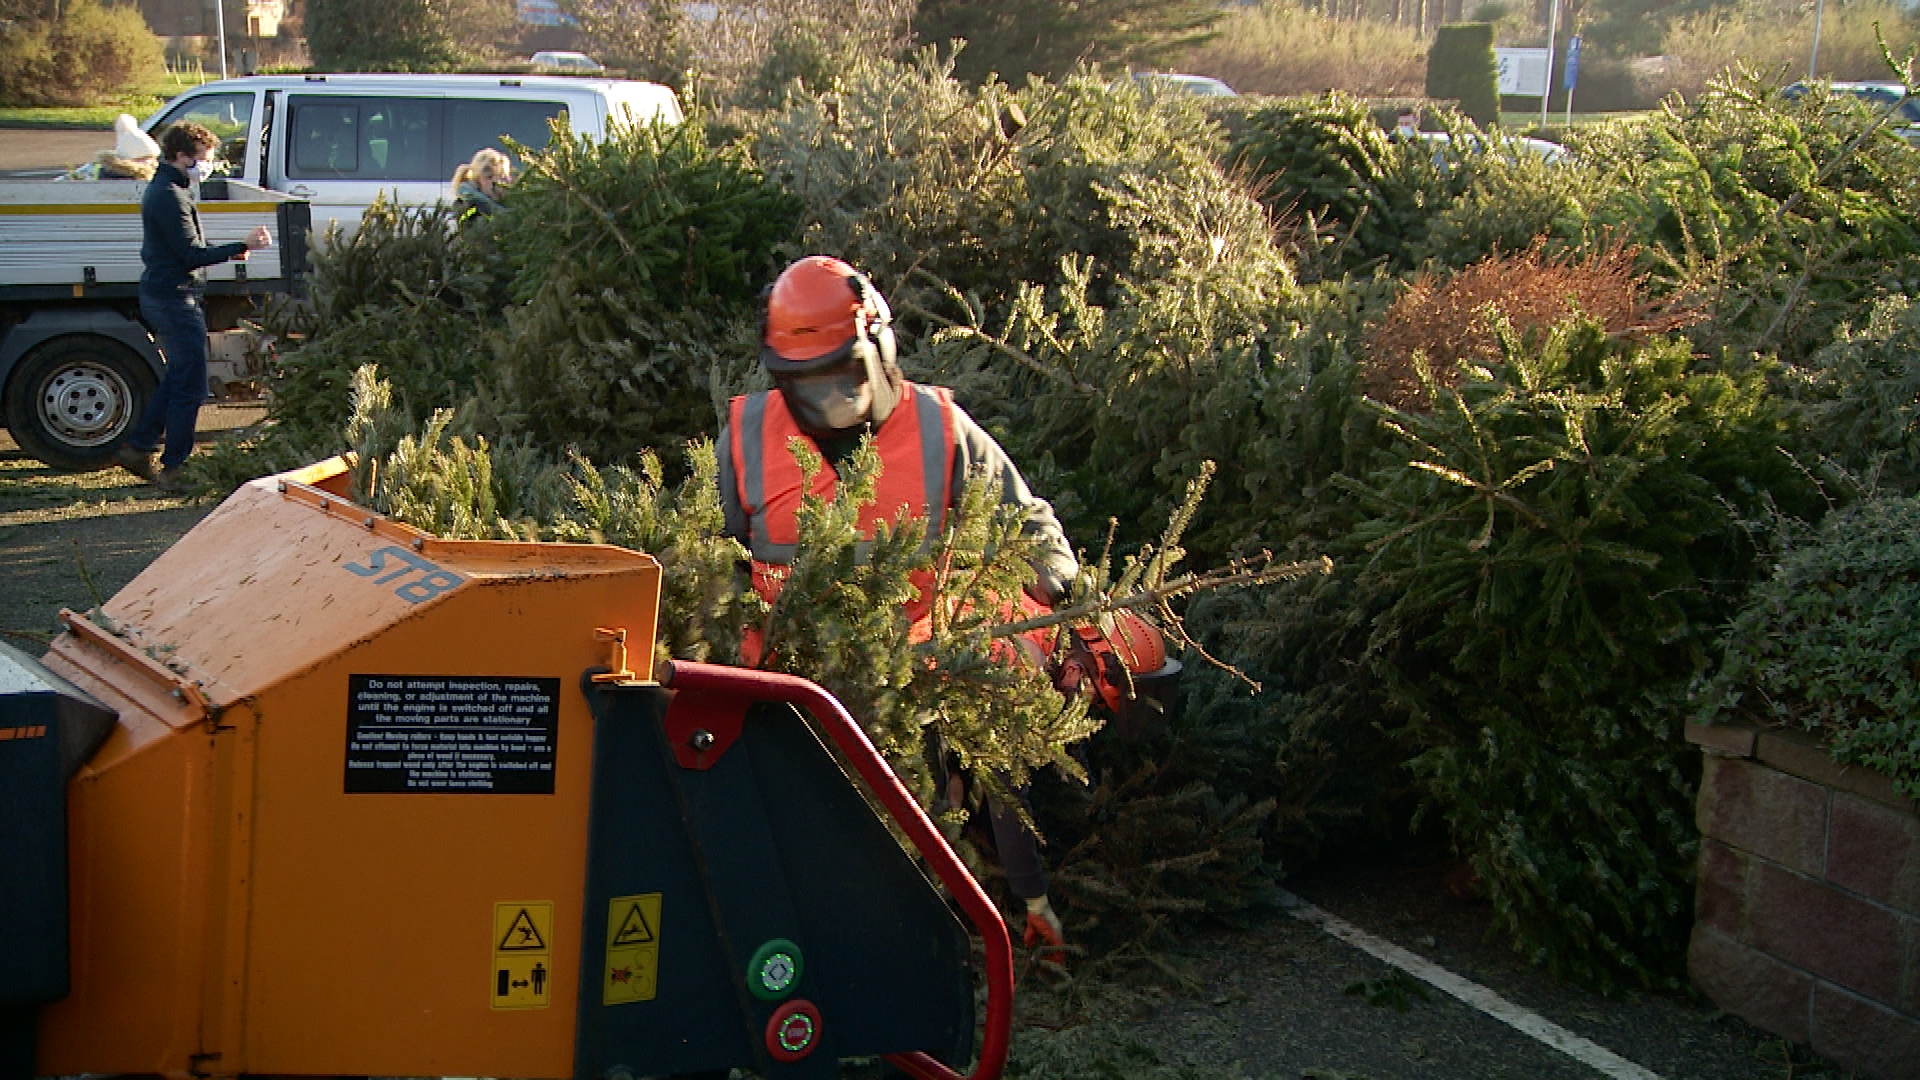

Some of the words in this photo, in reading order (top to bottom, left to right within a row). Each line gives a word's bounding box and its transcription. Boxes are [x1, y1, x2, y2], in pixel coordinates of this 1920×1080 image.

[342, 546, 465, 604] ST8
[369, 680, 383, 689] Do
[387, 680, 403, 689] not
[407, 681, 445, 690] attempt
[420, 692, 473, 702] adjustment
[477, 693, 488, 701] of
[491, 693, 507, 702] the
[511, 694, 550, 703] machine
[358, 702, 379, 711] until
[383, 703, 399, 711] the
[403, 704, 436, 713] engine
[439, 704, 448, 712] is
[452, 704, 495, 713] switched
[498, 704, 513, 713] off
[516, 704, 534, 713] and
[537, 705, 549, 714] all
[376, 713, 391, 722] the
[395, 714, 430, 724] moving
[434, 714, 459, 724] parts
[482, 714, 531, 726] stationary
